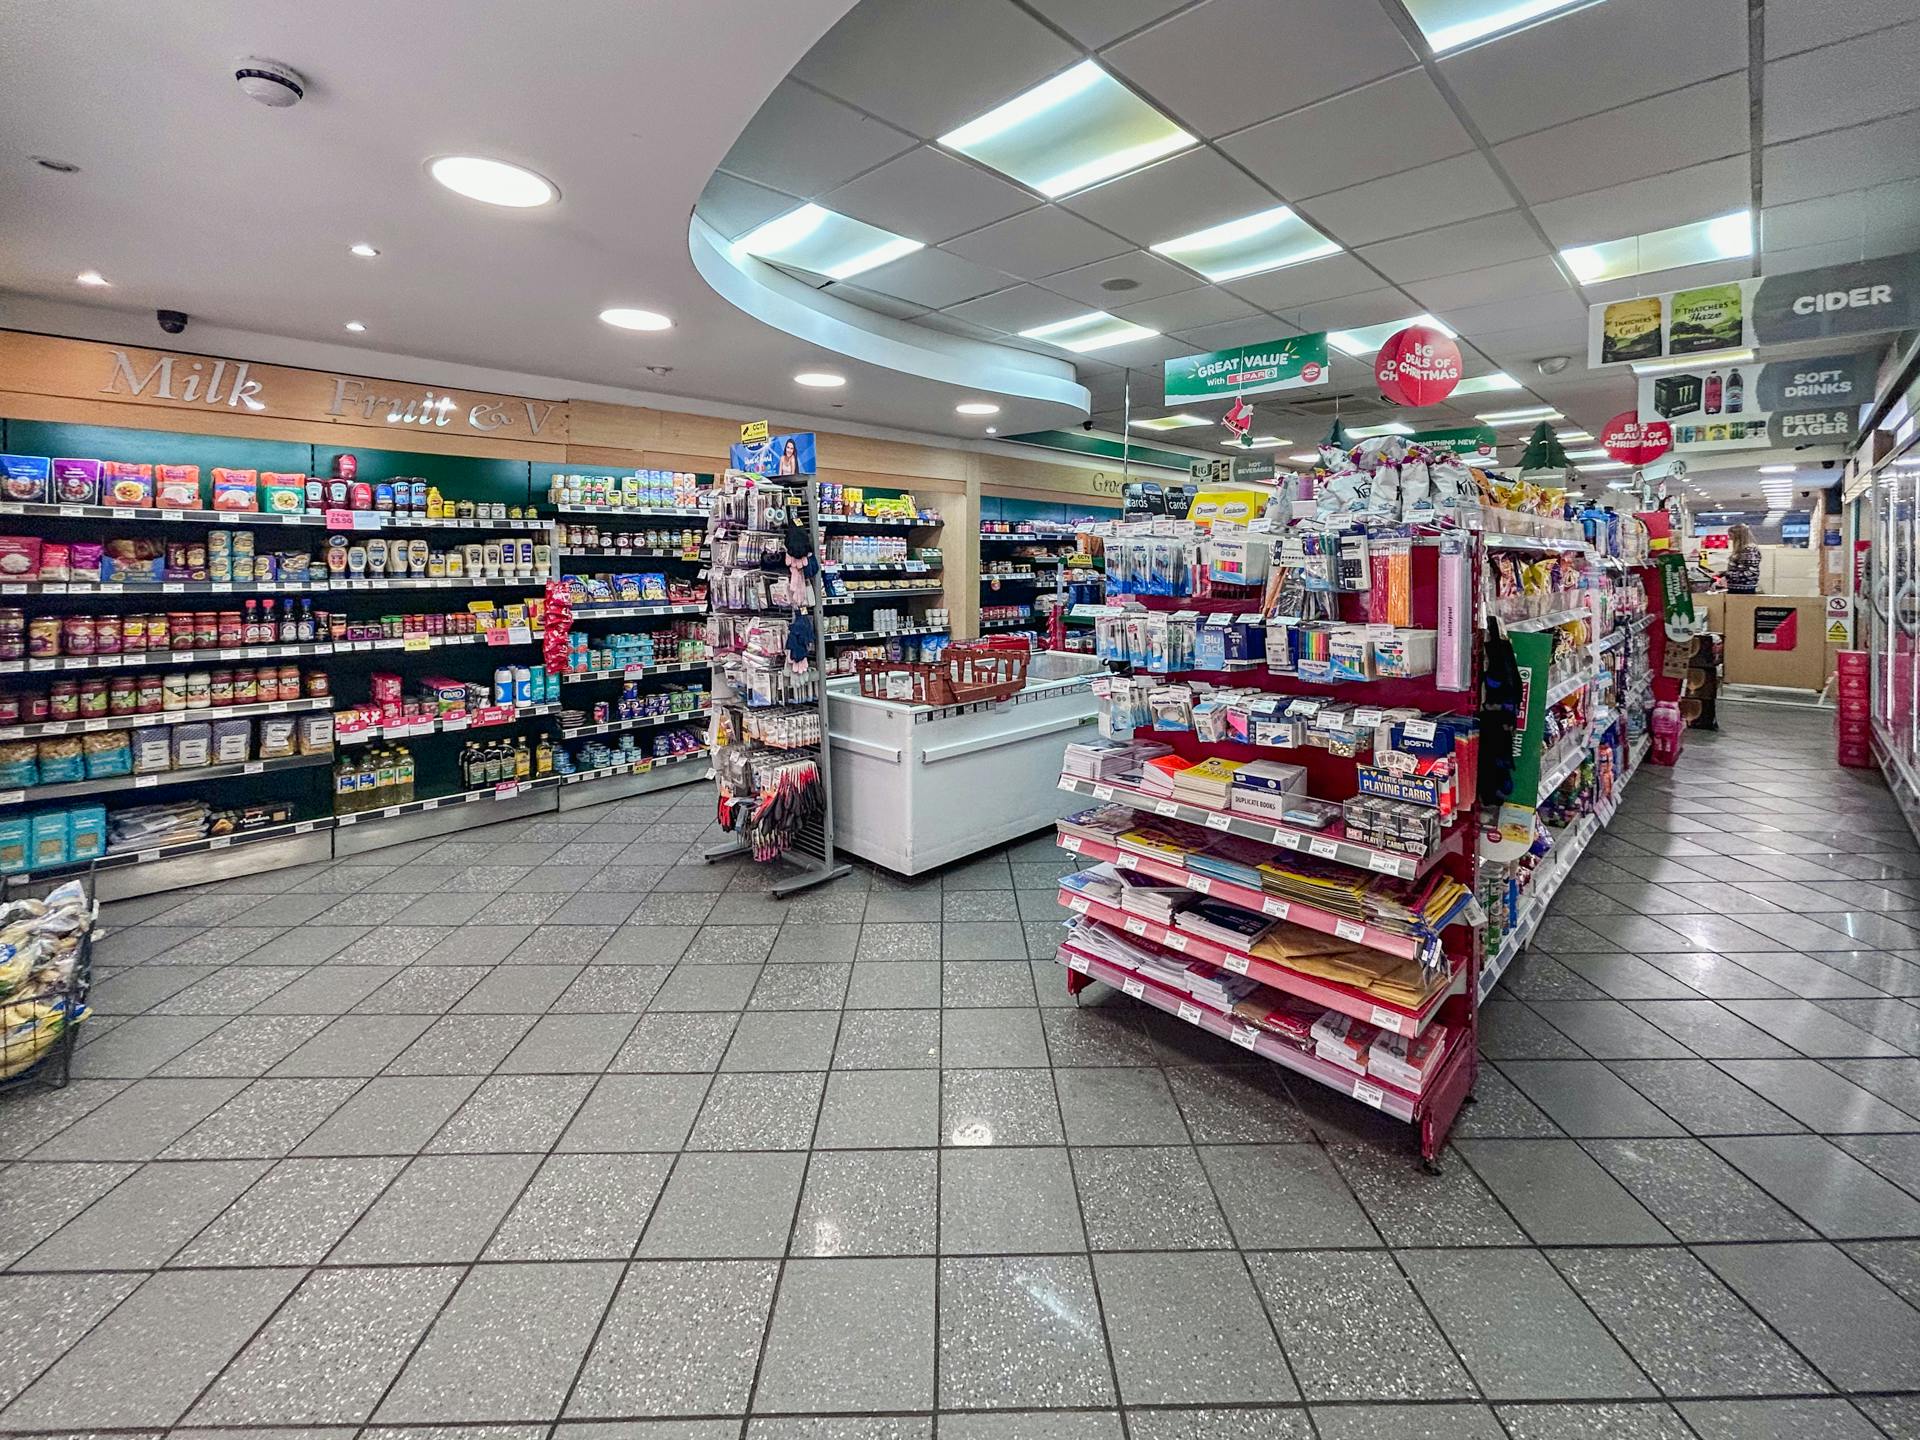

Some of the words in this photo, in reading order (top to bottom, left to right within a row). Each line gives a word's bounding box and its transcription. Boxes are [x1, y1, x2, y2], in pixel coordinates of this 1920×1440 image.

[1793, 284, 1892, 315] CIDER
[1683, 300, 1729, 314] THATCHERS
[1689, 311, 1722, 322] Haze
[1198, 357, 1240, 378] GREAT
[1243, 353, 1289, 368] VALUE
[1405, 352, 1431, 368] DEALS
[1434, 359, 1452, 369] OF
[98, 350, 266, 411] Milk
[1206, 377, 1225, 387] With
[1235, 371, 1266, 383] SPAR
[1793, 370, 1843, 385] SOFT
[1784, 381, 1852, 398] DRINKS
[325, 378, 456, 427] Fruit
[467, 401, 514, 431] &
[752, 422, 767, 431] CCTV
[1782, 412, 1829, 428] BEER
[1833, 411, 1849, 424] &
[1649, 431, 1663, 439] OF
[1782, 422, 1849, 438] LAGER
[396, 485, 409, 493] HP
[415, 485, 427, 493] HP
[1127, 496, 1149, 508] cards
[1168, 499, 1188, 510] cards
[1671, 571, 1682, 597] VALUE
[1203, 635, 1221, 644] Blu
[1200, 643, 1225, 653] Tack
[1404, 739, 1434, 749] BOSTIK
[1512, 733, 1524, 757] With
[1377, 774, 1398, 784] PLASTIC
[1363, 779, 1400, 796] PLAYING
[1402, 786, 1432, 802] CARDS
[1235, 796, 1259, 808] DUPLICATE
[1259, 802, 1276, 810] BOOKS
